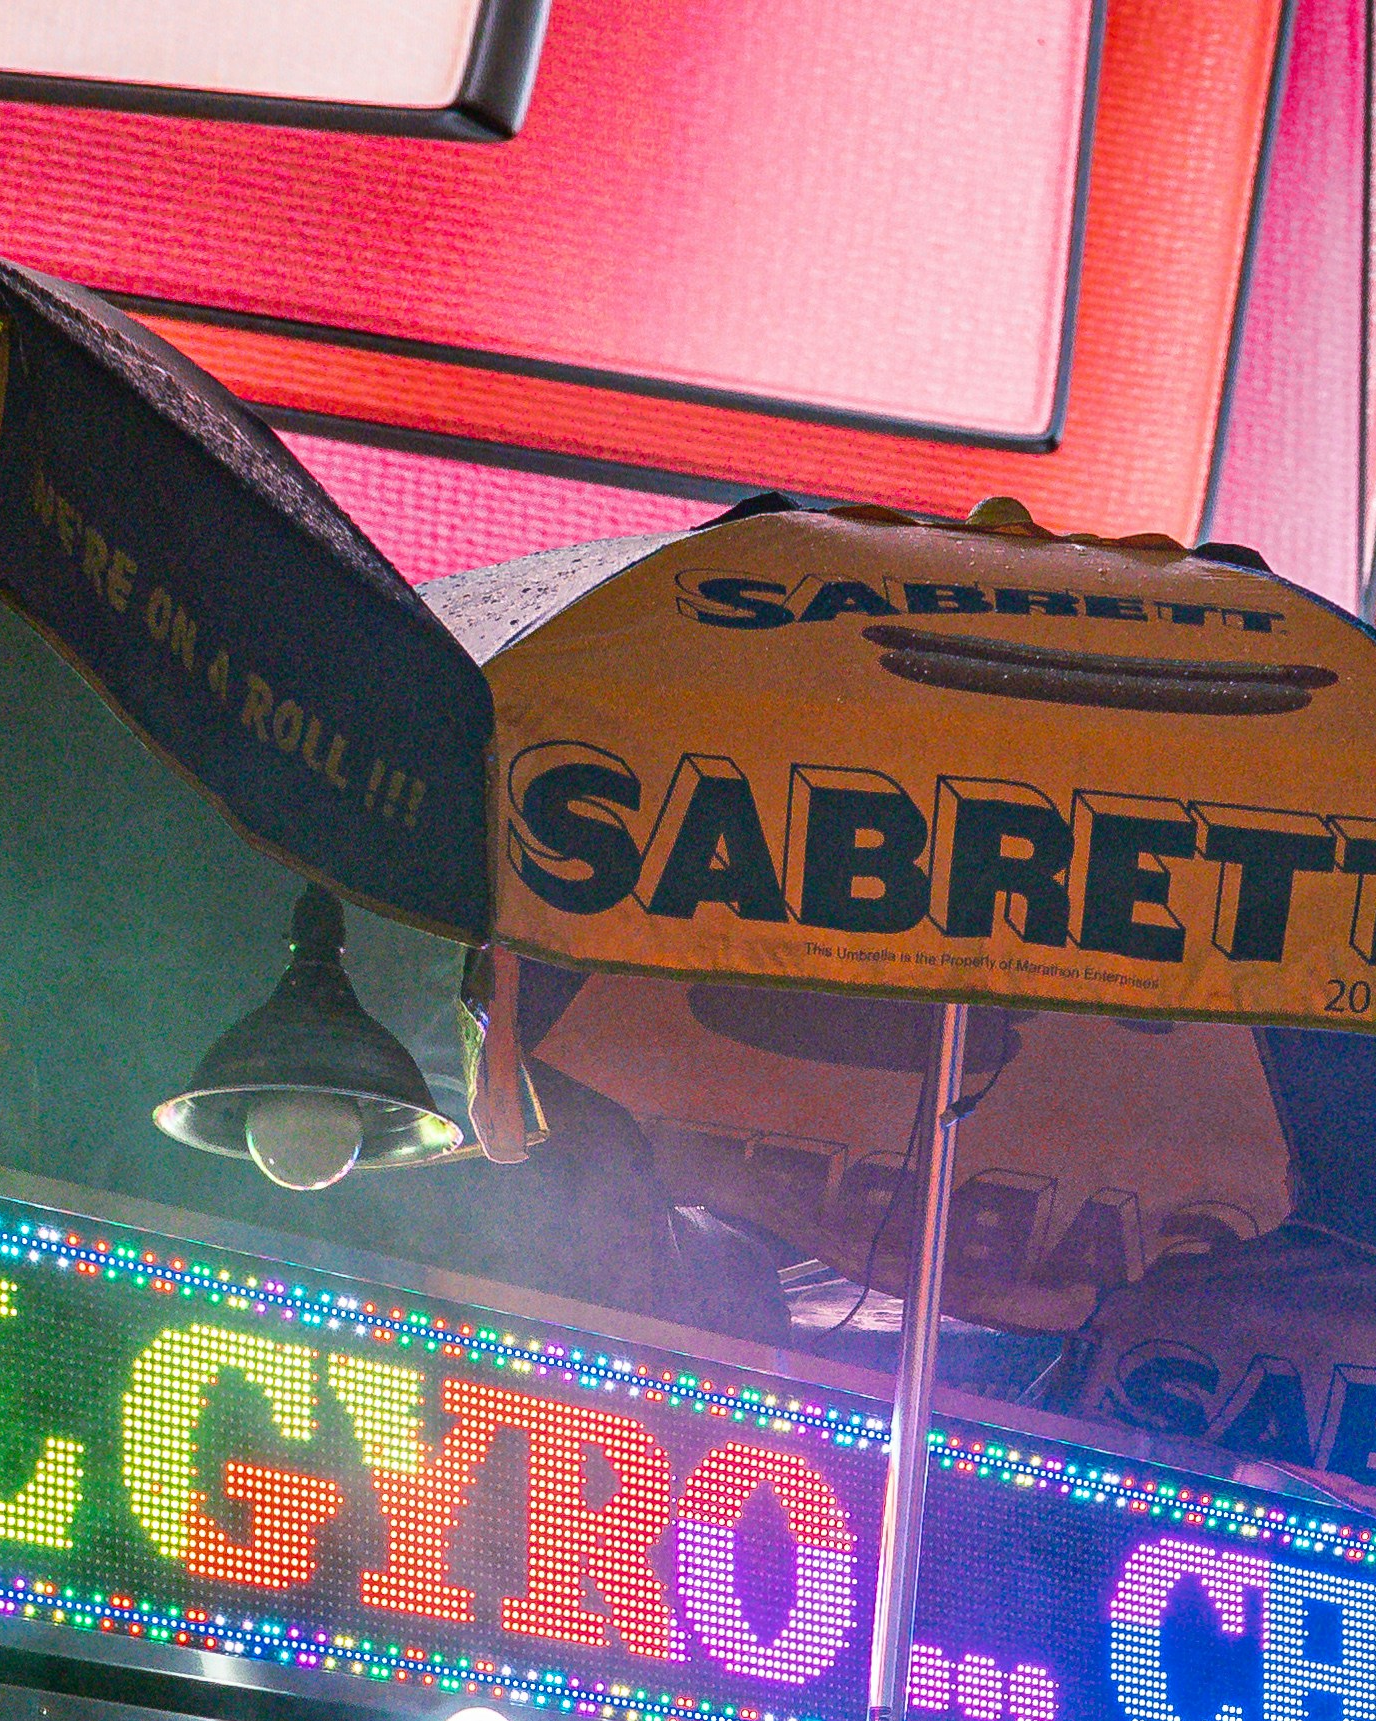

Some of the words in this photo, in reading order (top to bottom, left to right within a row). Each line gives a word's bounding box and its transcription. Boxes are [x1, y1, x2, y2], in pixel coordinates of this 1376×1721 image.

[674, 565, 1286, 636] SABRETT
[147, 585, 198, 672] ON
[208, 649, 230, 693] A
[241, 672, 349, 790] ROLL
[837, 947, 895, 962] Umbrella
[915, 952, 936, 965] the
[940, 953, 995, 972] Property
[999, 958, 1014, 970] of
